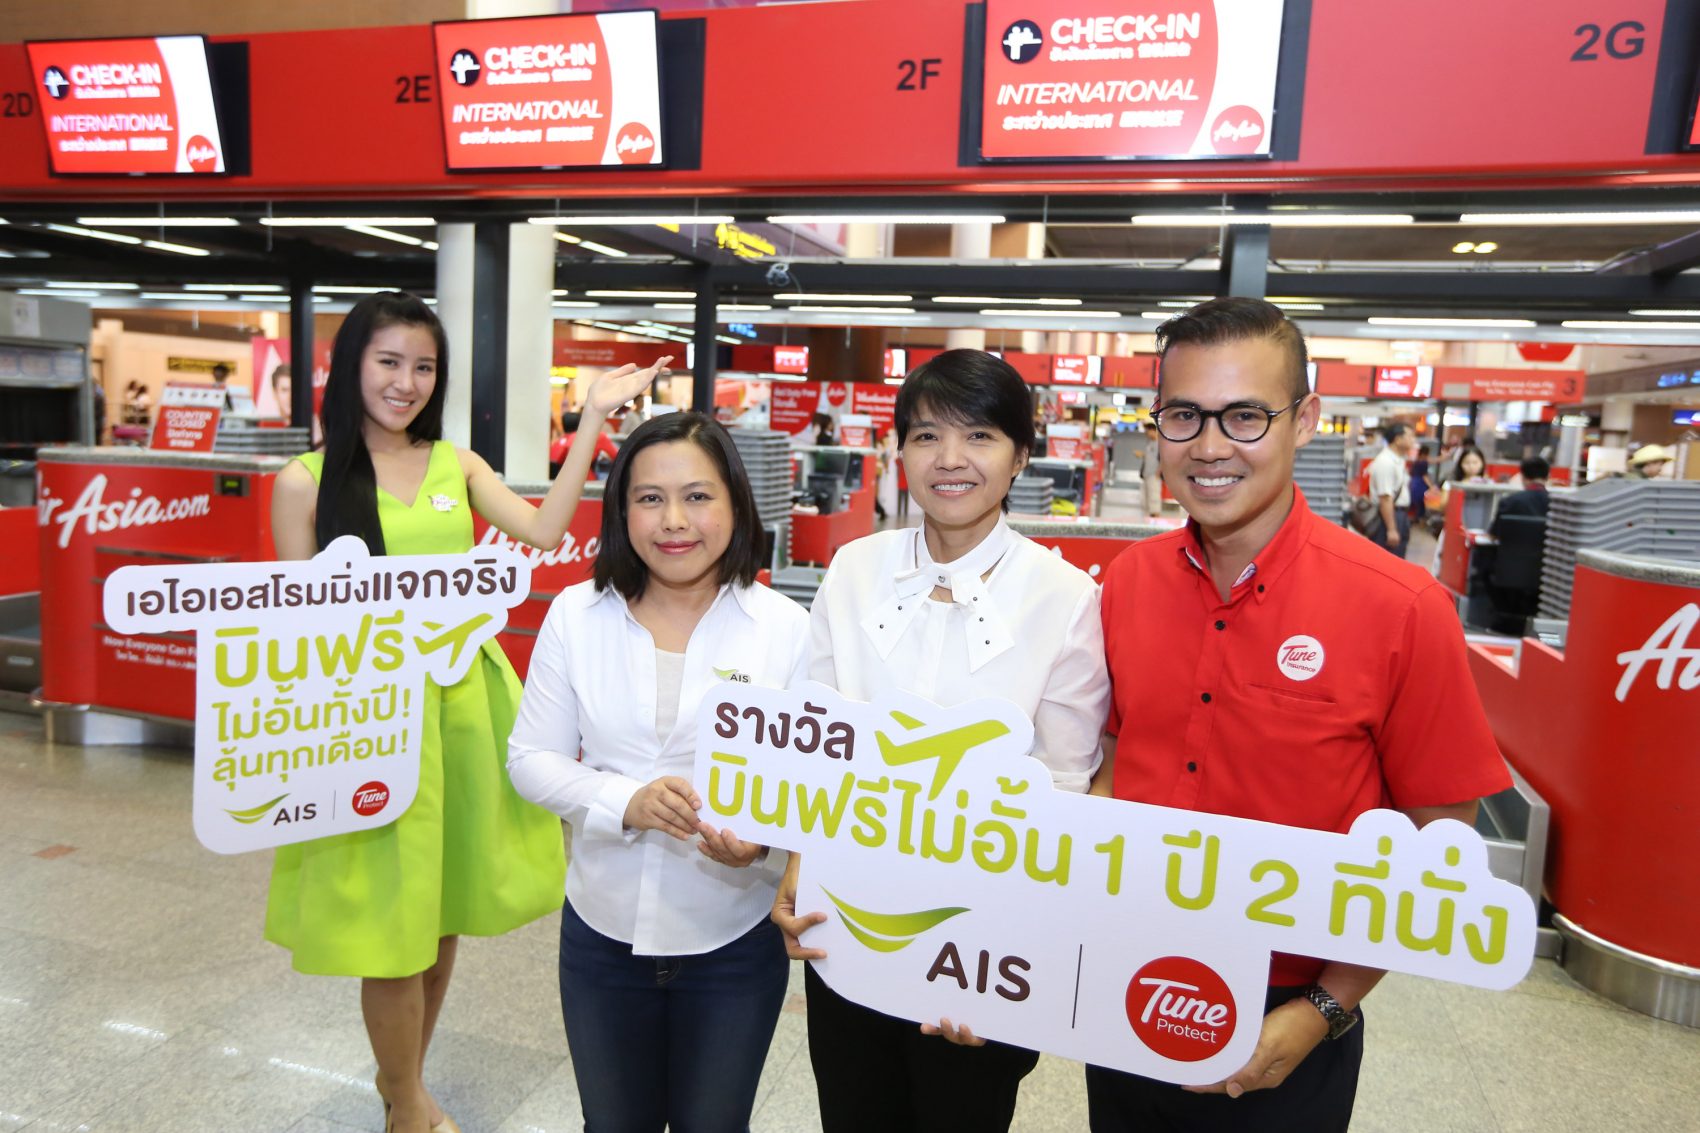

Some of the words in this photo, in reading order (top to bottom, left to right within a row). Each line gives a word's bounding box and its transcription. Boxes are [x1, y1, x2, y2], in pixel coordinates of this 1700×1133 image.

[1050, 12, 1201, 45] CHECK-IN
[1570, 20, 1645, 62] 2G
[485, 42, 596, 71] CHECK-IN
[70, 63, 162, 86] CHECK-IN
[896, 58, 942, 91] 2F
[395, 76, 432, 103] 2E
[997, 78, 1199, 106] INTERNATIONAL
[2, 92, 34, 118] 2D
[452, 99, 604, 123] INTERNATIONAL
[51, 114, 174, 133] INTERNATIONAL
[1562, 377, 1577, 396] 3
[214, 609, 405, 687] บินฟรี
[1281, 645, 1317, 664] Tune
[730, 674, 749, 683] AIS
[211, 677, 411, 742] ไม่อั้นทั้งปี!
[714, 701, 855, 761] รางวัล
[212, 729, 408, 791] ลุ้นทุกเดือน!
[356, 789, 387, 808] Tune
[273, 803, 317, 826] AIS
[1094, 834, 1125, 896] 1
[1162, 829, 1220, 911] ปี
[1245, 859, 1299, 927] 2
[1329, 835, 1508, 965] ที่นั่ง
[926, 941, 1032, 1002] AIS
[1139, 976, 1228, 1028] Tune
[1156, 1017, 1217, 1044] Protect
